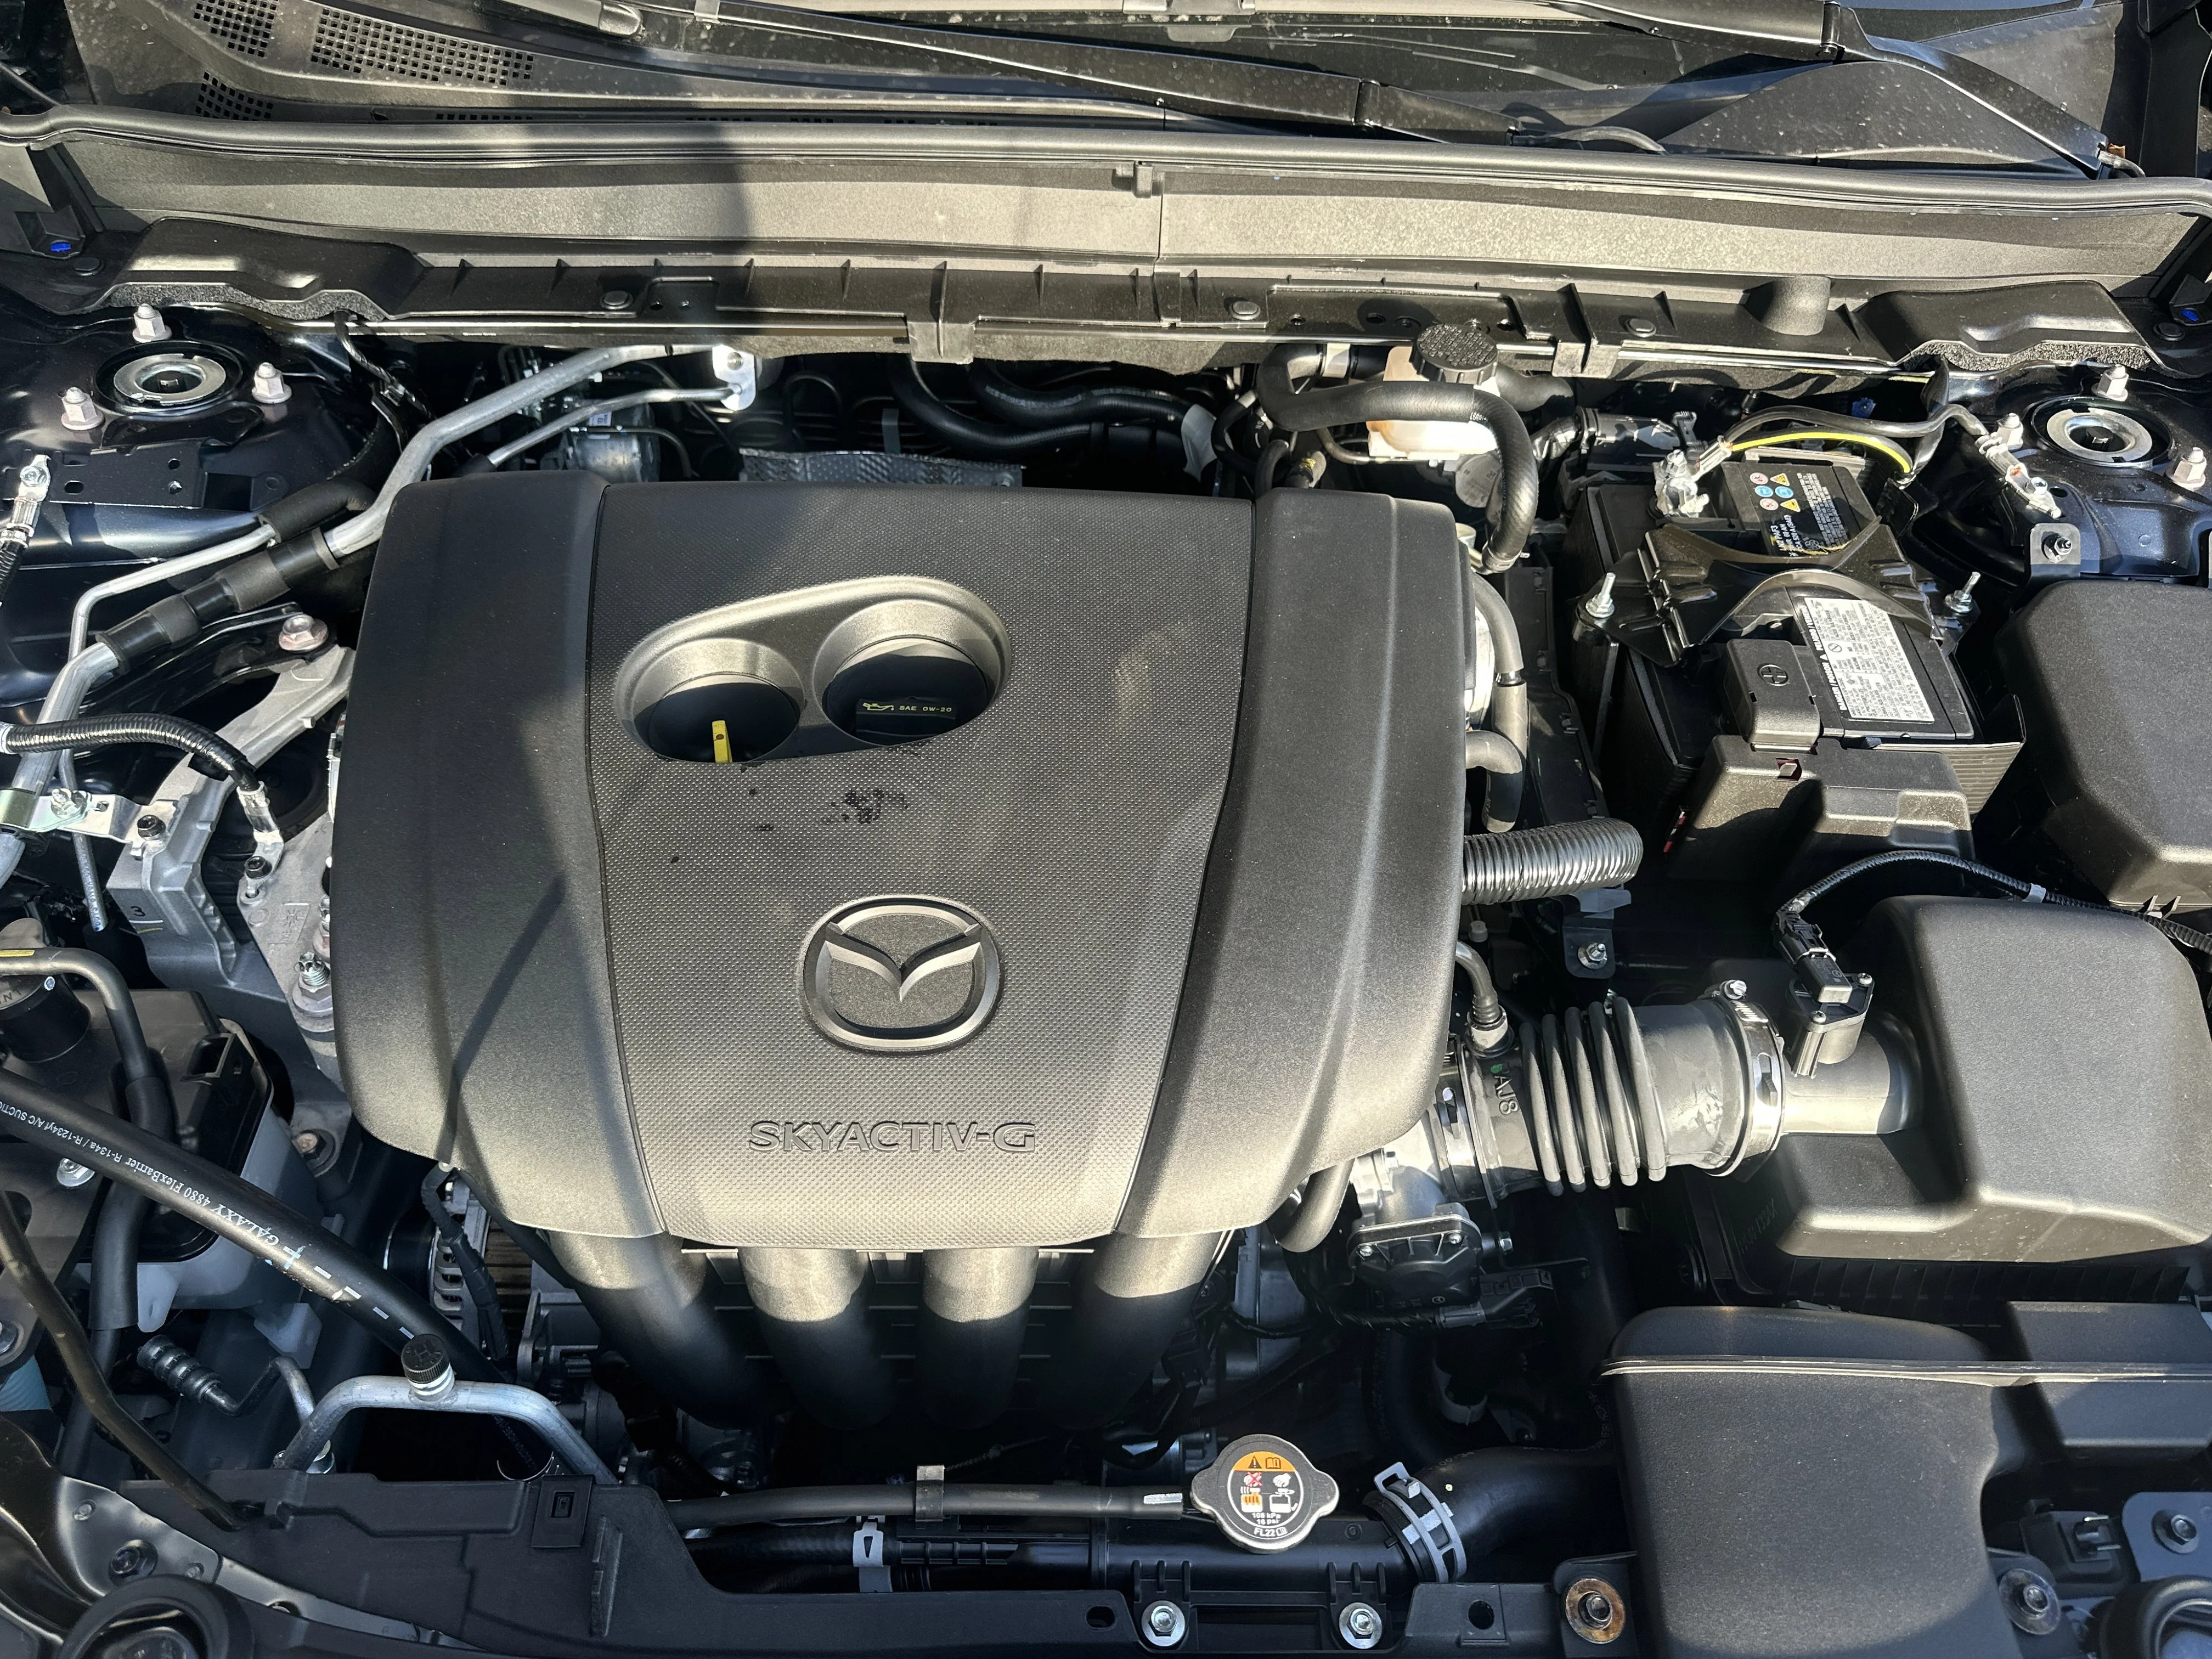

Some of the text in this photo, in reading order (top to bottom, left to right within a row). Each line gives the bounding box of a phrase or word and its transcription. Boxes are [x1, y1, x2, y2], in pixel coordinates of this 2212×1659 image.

[131, 906, 145, 917] 3
[28, 1115, 45, 1127] A/C
[44, 1122, 83, 1146] R-1234yf
[748, 1121, 1036, 1152] SKYACTIV-G
[90, 1141, 122, 1163] R-134a
[125, 1157, 185, 1193] FlexBarrier
[184, 1187, 211, 1206] 4880
[211, 1204, 279, 1245] GALAXY
[1254, 1527, 1276, 1537] FL22
